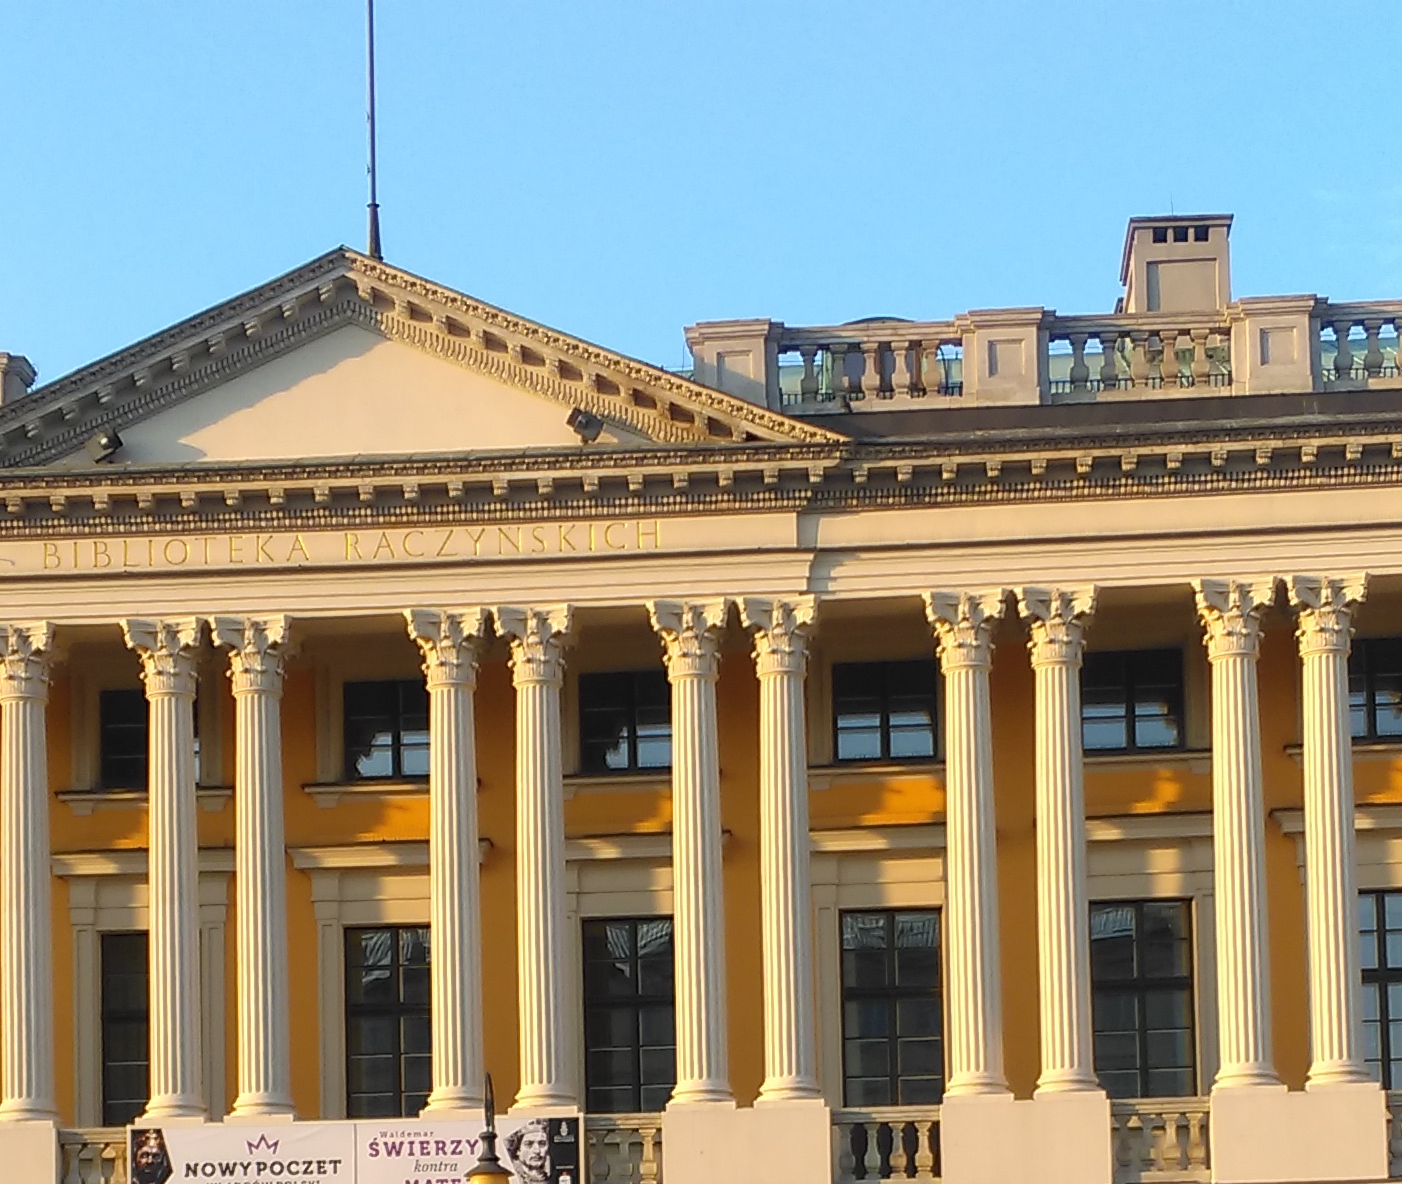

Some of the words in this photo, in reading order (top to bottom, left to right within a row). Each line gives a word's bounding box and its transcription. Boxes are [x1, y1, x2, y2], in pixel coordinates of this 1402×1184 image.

[43, 534, 310, 569] BIBLIOTEKA
[368, 1137, 479, 1158] ŚWIERZY
[184, 1161, 252, 1178] NOWY
[256, 1159, 342, 1177] POCZET
[414, 1160, 458, 1173] kontra
